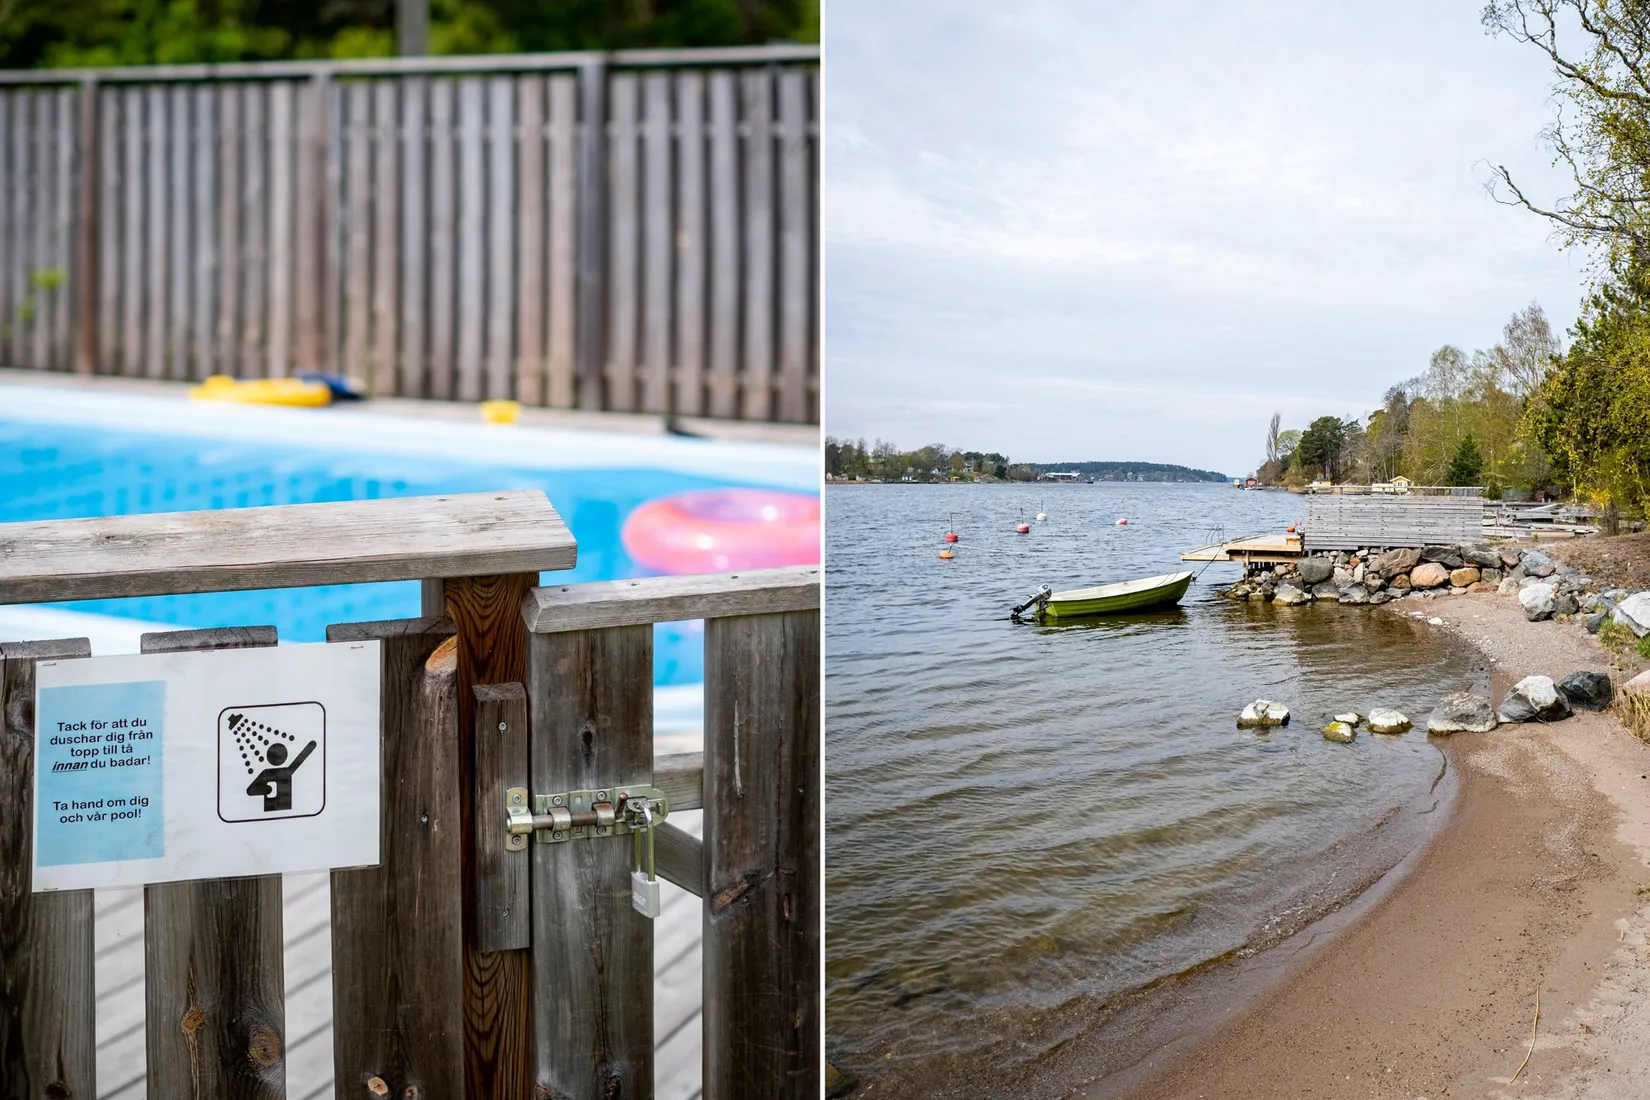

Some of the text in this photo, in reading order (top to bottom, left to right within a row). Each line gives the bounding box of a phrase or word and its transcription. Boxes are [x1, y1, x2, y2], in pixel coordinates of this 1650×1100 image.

[57, 718, 147, 732] Tack för att du
[50, 730, 153, 745] duschar dig från
[70, 743, 133, 758] topp till tå
[52, 756, 150, 771] innan du badar!
[53, 796, 149, 810] Ta hand om dig
[60, 809, 141, 823] och vår pool!
